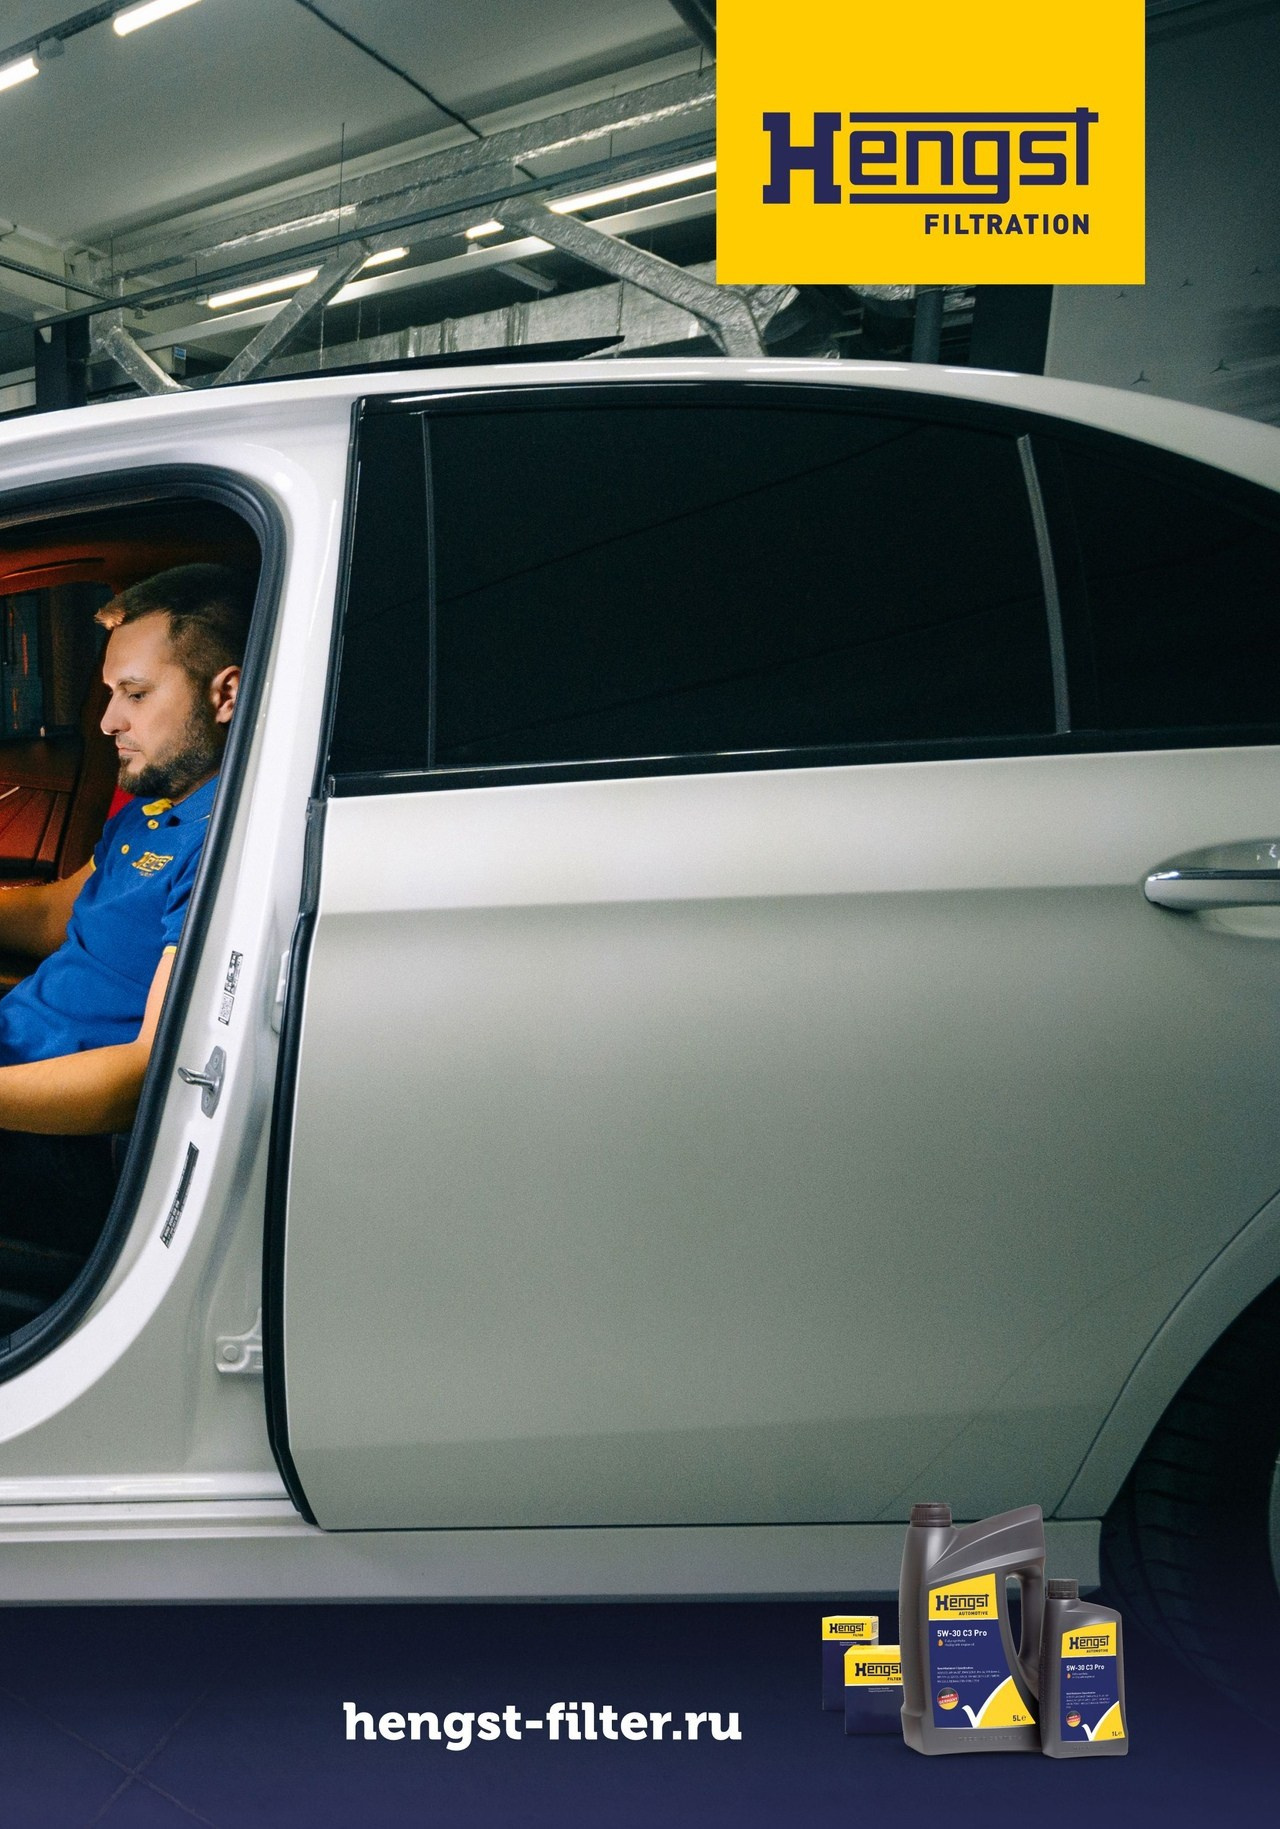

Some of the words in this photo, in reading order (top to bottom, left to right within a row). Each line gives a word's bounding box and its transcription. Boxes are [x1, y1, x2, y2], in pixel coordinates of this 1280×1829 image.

[935, 1594, 990, 1611] Hengst
[829, 1623, 864, 1633] Hengst
[937, 1629, 961, 1637] 5W-30
[962, 1629, 973, 1637] C3
[974, 1629, 988, 1637] Pro
[1069, 1635, 1110, 1649] Hengst
